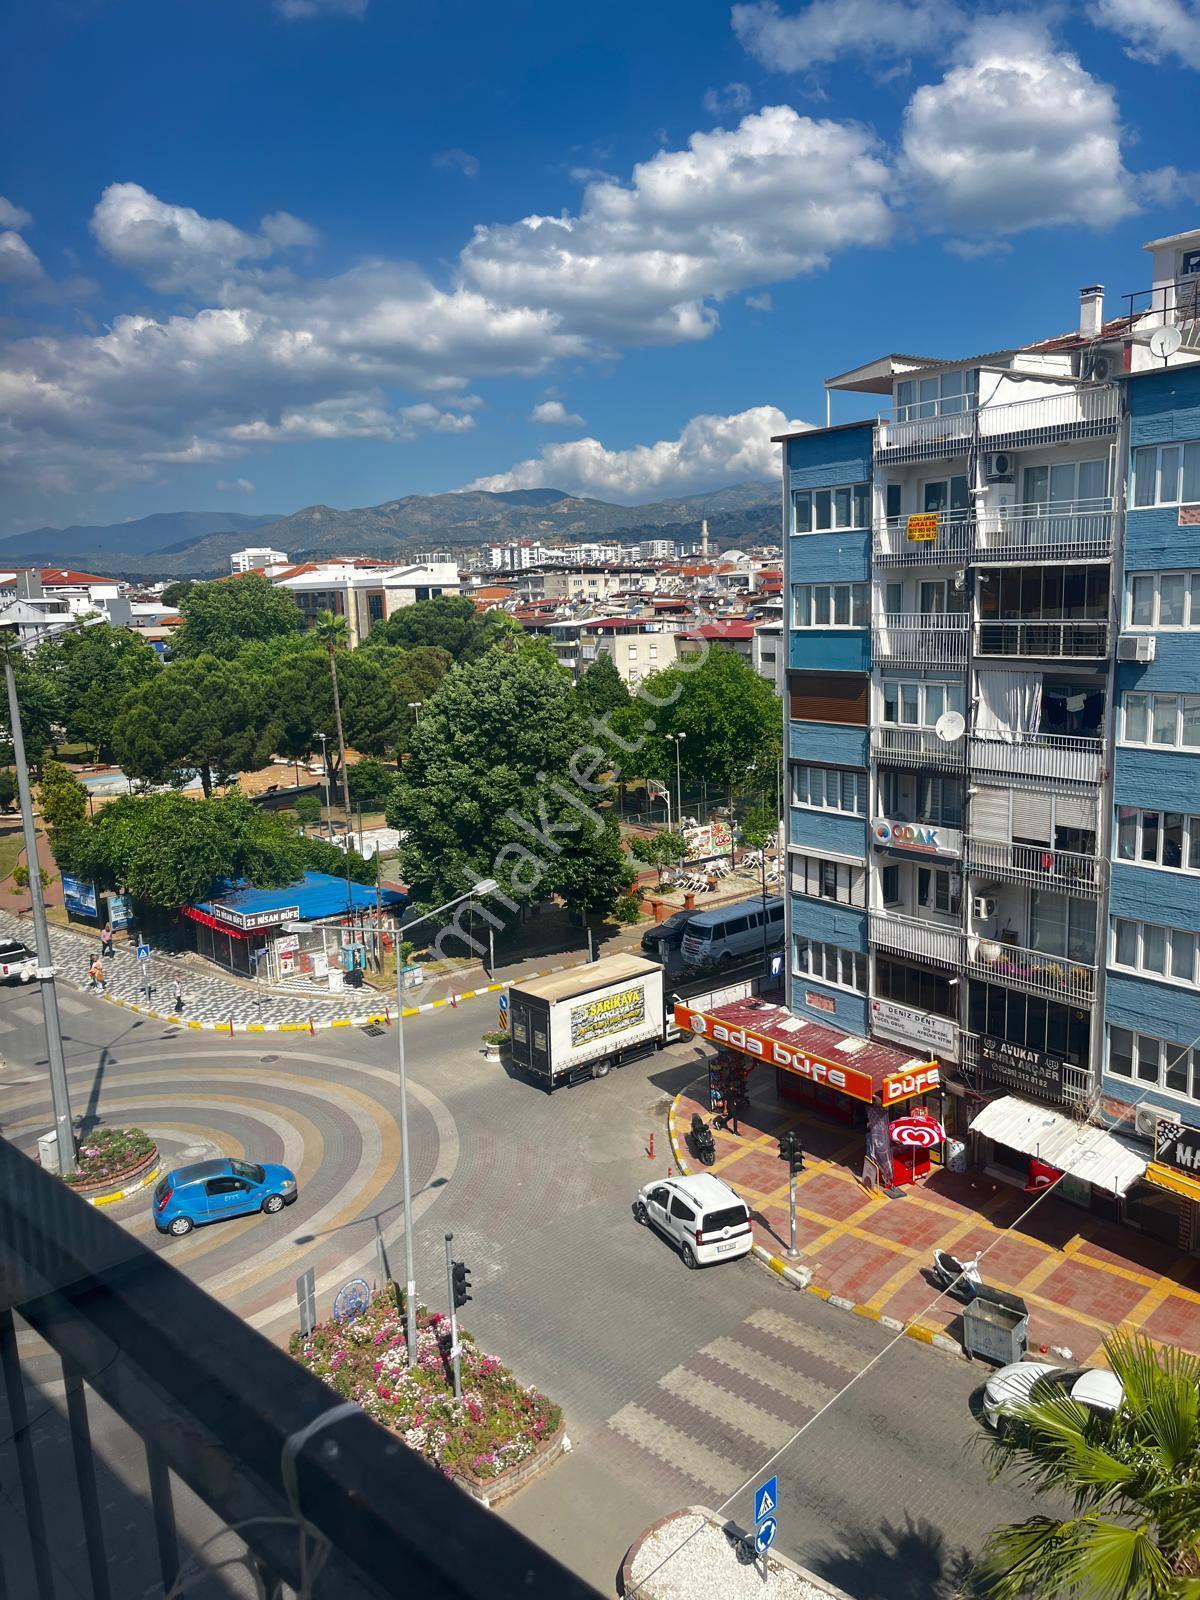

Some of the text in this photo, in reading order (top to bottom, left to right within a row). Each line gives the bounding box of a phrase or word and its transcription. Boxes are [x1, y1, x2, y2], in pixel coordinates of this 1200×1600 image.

[891, 824, 938, 844] ODAK
[246, 909, 299, 927] 23 NİSAN BÜFE
[589, 991, 639, 1017] SARIKAYA
[888, 1007, 912, 1018] DENİZ
[914, 1015, 936, 1027] DENT
[713, 1024, 846, 1088] ada büfe
[982, 1048, 1015, 1067] ZEHRA
[1000, 1043, 1040, 1063] AVUKAT
[888, 1067, 940, 1099] büfe
